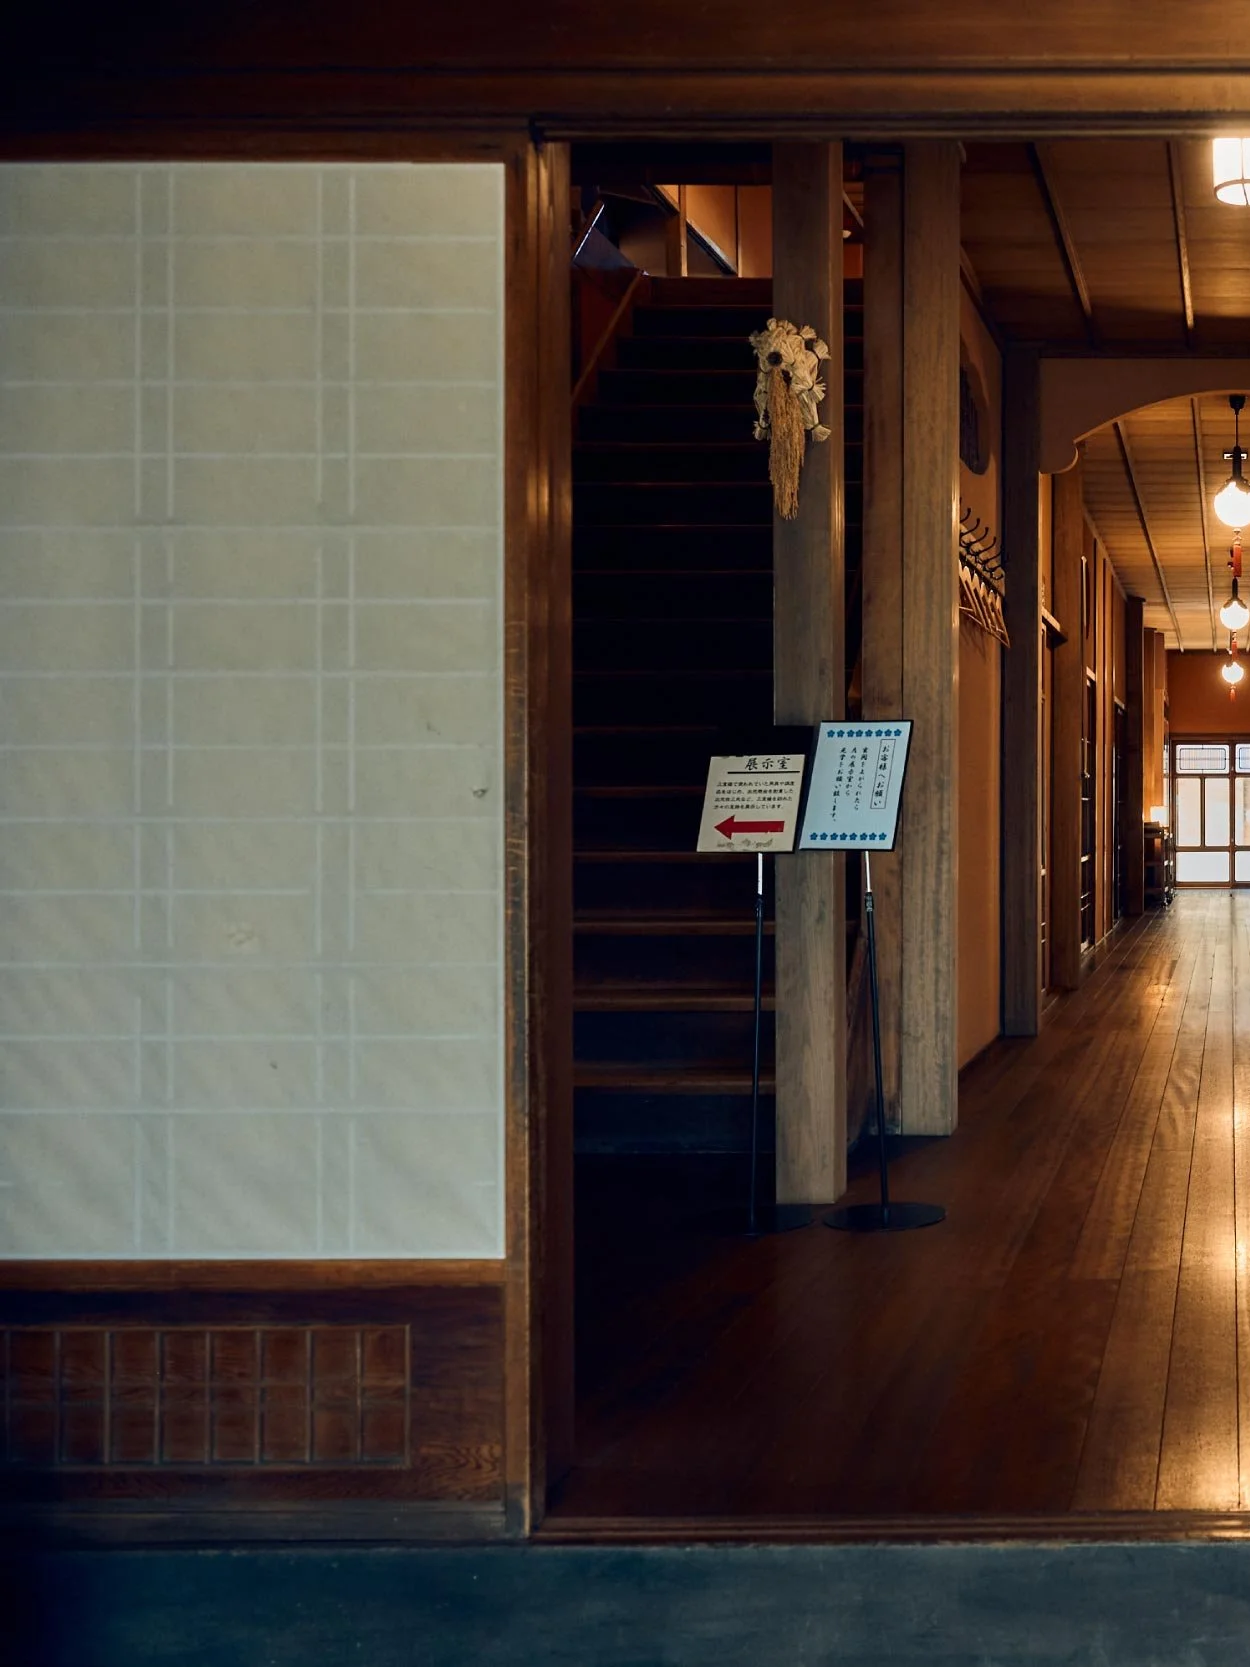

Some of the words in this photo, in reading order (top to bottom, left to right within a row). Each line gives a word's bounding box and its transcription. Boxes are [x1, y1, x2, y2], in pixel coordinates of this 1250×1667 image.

[744, 756, 791, 771] 展示室
[873, 744, 890, 807] お客様へお願い
